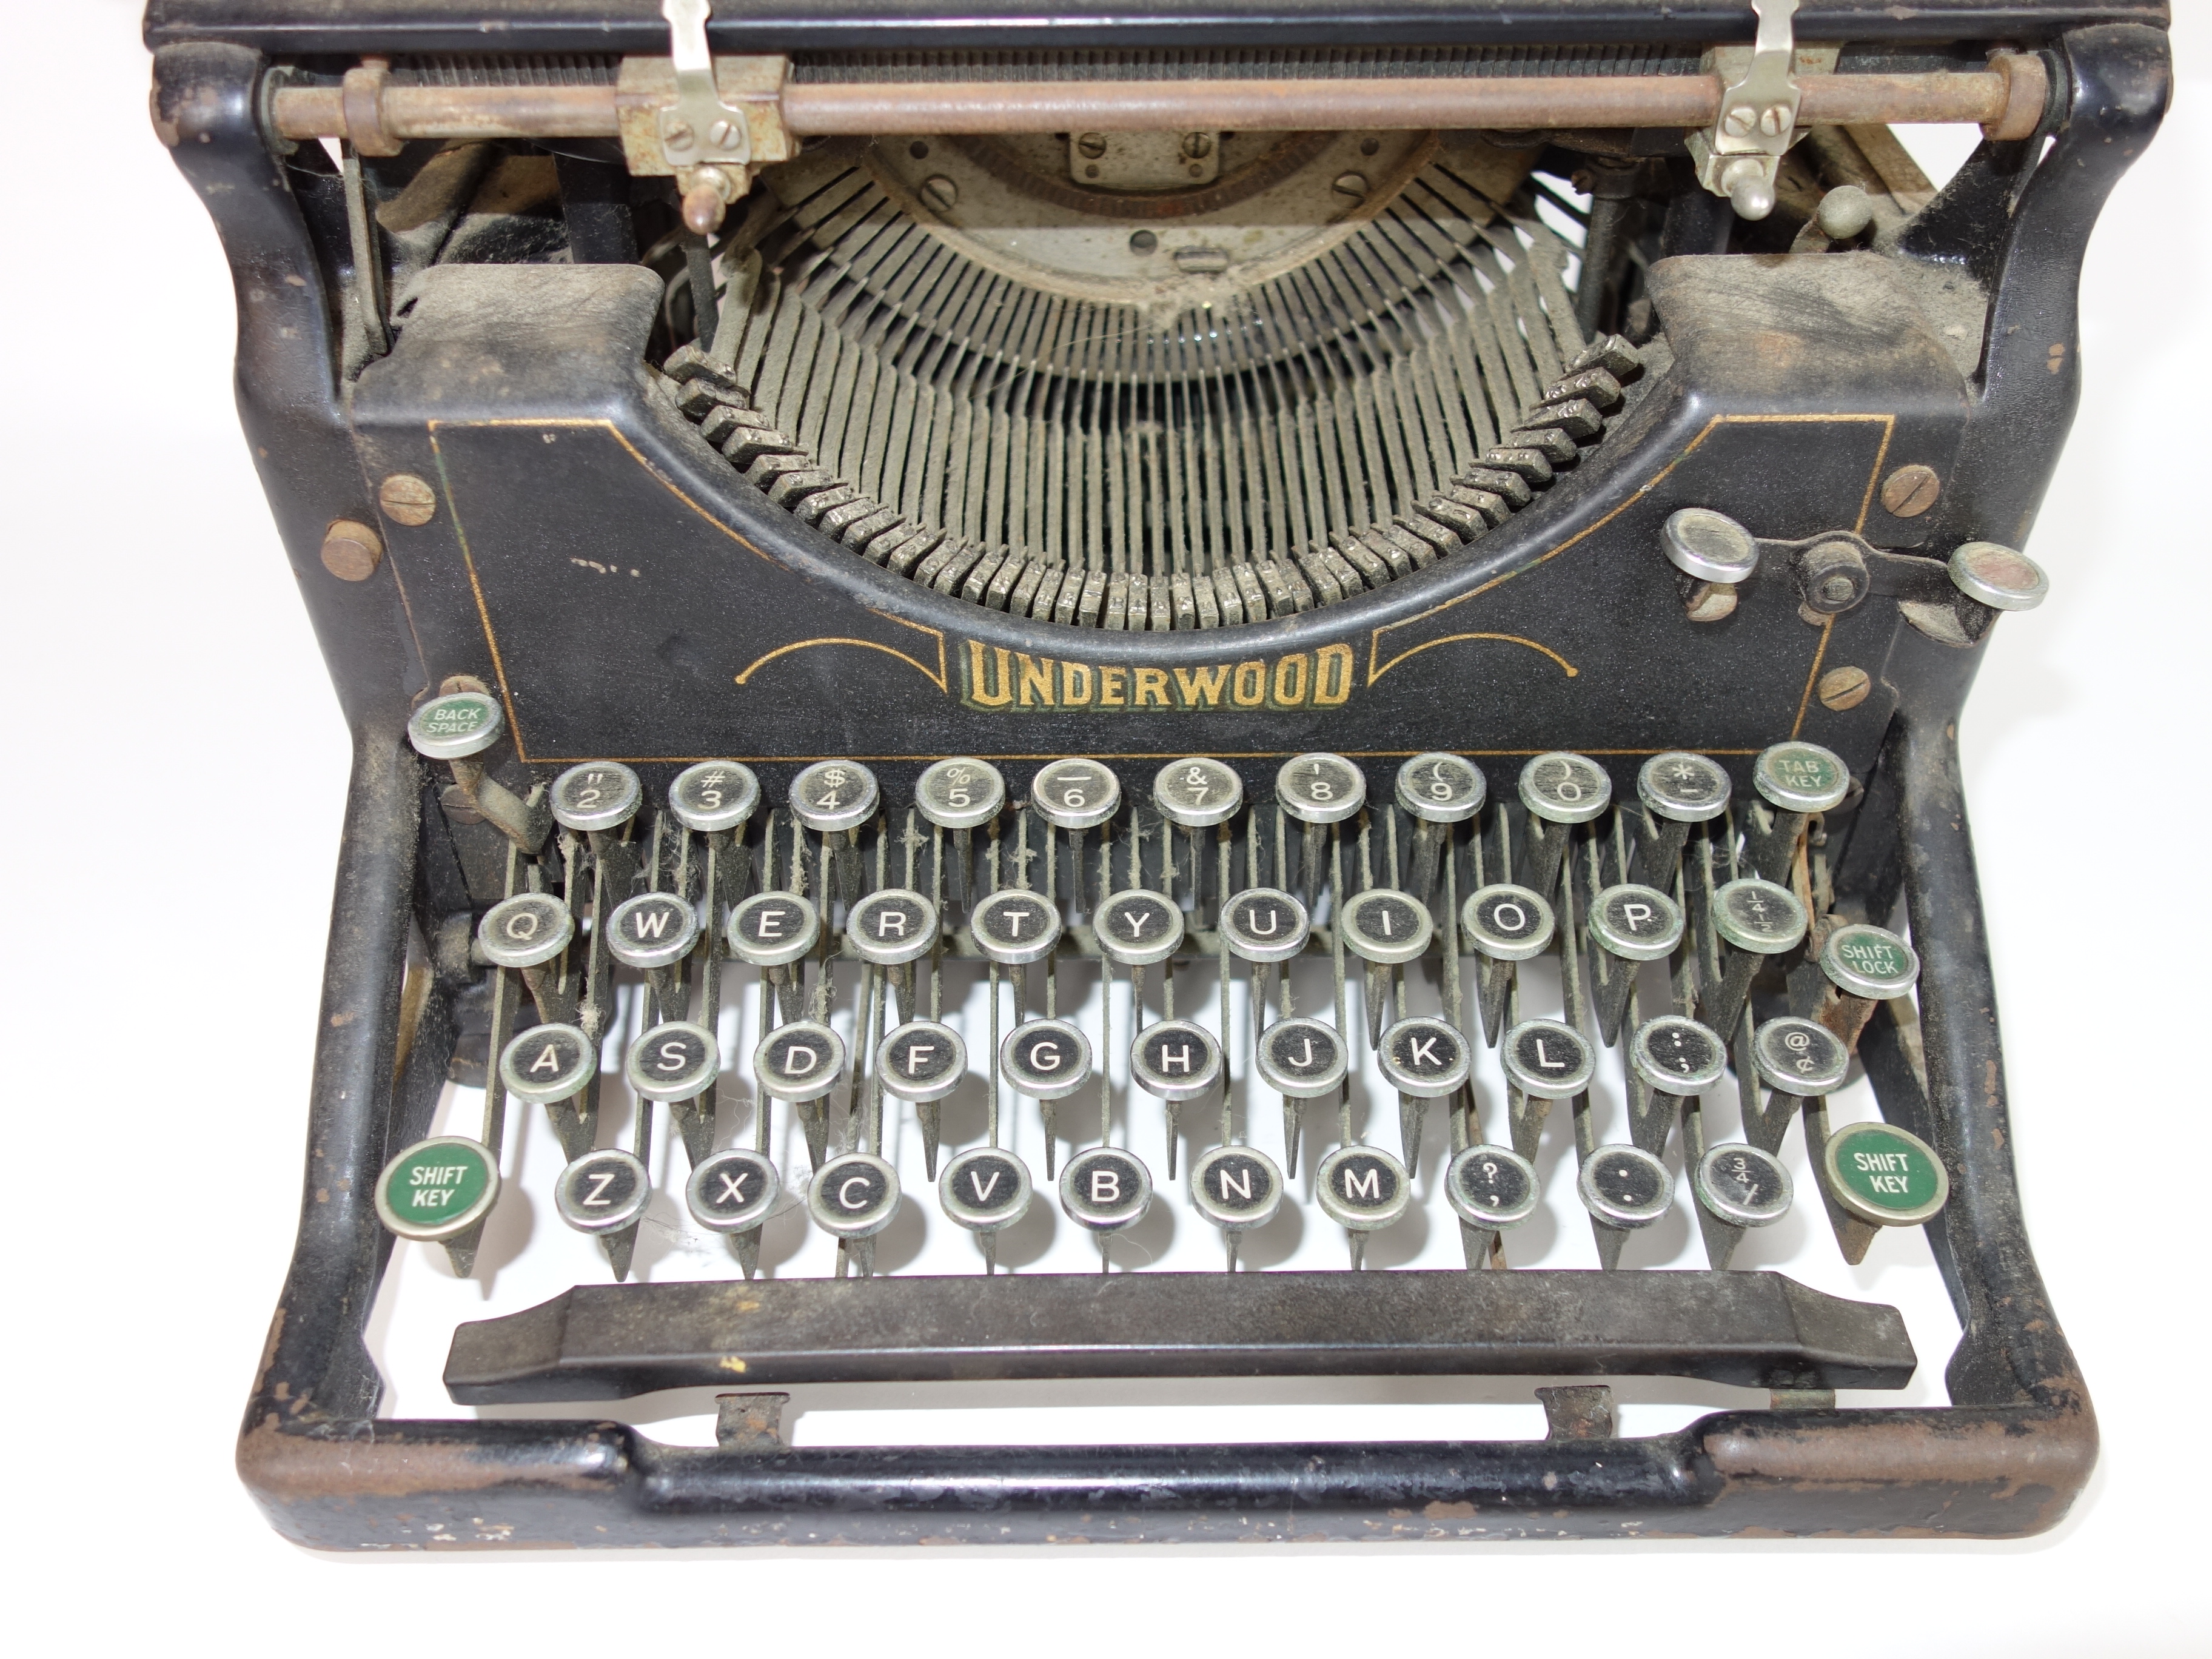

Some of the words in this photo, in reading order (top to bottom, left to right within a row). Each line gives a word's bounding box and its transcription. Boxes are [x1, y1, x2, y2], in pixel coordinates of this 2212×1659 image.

[960, 640, 1355, 711] UNDERWOOD
[434, 708, 480, 720] BACK
[426, 720, 478, 733] SPACE
[824, 769, 846, 788] $
[947, 768, 970, 785] %
[1187, 766, 1207, 785] &
[1432, 761, 1444, 782] (
[1560, 760, 1572, 780] )
[1779, 760, 1818, 774] TAB
[701, 770, 726, 788] #
[1785, 774, 1822, 787] KEY
[579, 789, 600, 809] 2
[699, 790, 722, 809] 3
[816, 791, 840, 809] 4
[949, 788, 970, 807] 5
[1063, 789, 1084, 807] 6
[1187, 787, 1210, 805] 7
[1311, 782, 1333, 800] 8
[1430, 782, 1453, 801] 9
[506, 912, 538, 940] Q
[635, 911, 669, 938] W
[759, 911, 785, 937] E
[878, 911, 906, 937] R
[1003, 912, 1030, 937] T
[1124, 912, 1150, 937] Y
[1250, 910, 1276, 934] U
[1382, 910, 1392, 936] I
[1493, 903, 1526, 931] O
[1623, 904, 1652, 931] P
[1842, 945, 1892, 959] SHIFT
[1853, 960, 1898, 974] LOCK
[1288, 1039, 1311, 1067] J
[1411, 1037, 1441, 1066] K
[1537, 1039, 1565, 1067] L
[1785, 1032, 1810, 1051] @
[530, 1044, 558, 1073] A
[657, 1042, 686, 1071] S
[784, 1046, 817, 1074] D
[908, 1045, 934, 1074] F
[1030, 1042, 1061, 1070] G
[1162, 1045, 1190, 1072] H
[1483, 1162, 1497, 1184] ?
[1853, 1153, 1908, 1170] SHIFT
[409, 1165, 468, 1185] SHIFT
[970, 1171, 1000, 1202] V
[1092, 1171, 1120, 1202] B
[1220, 1170, 1252, 1200] N
[1345, 1168, 1380, 1199] M
[1868, 1175, 1909, 1193] KEY
[412, 1190, 454, 1207] KEY
[583, 1174, 614, 1205] Z
[716, 1173, 747, 1204] X
[839, 1178, 870, 1209] C
[1742, 1184, 1758, 1205] /
